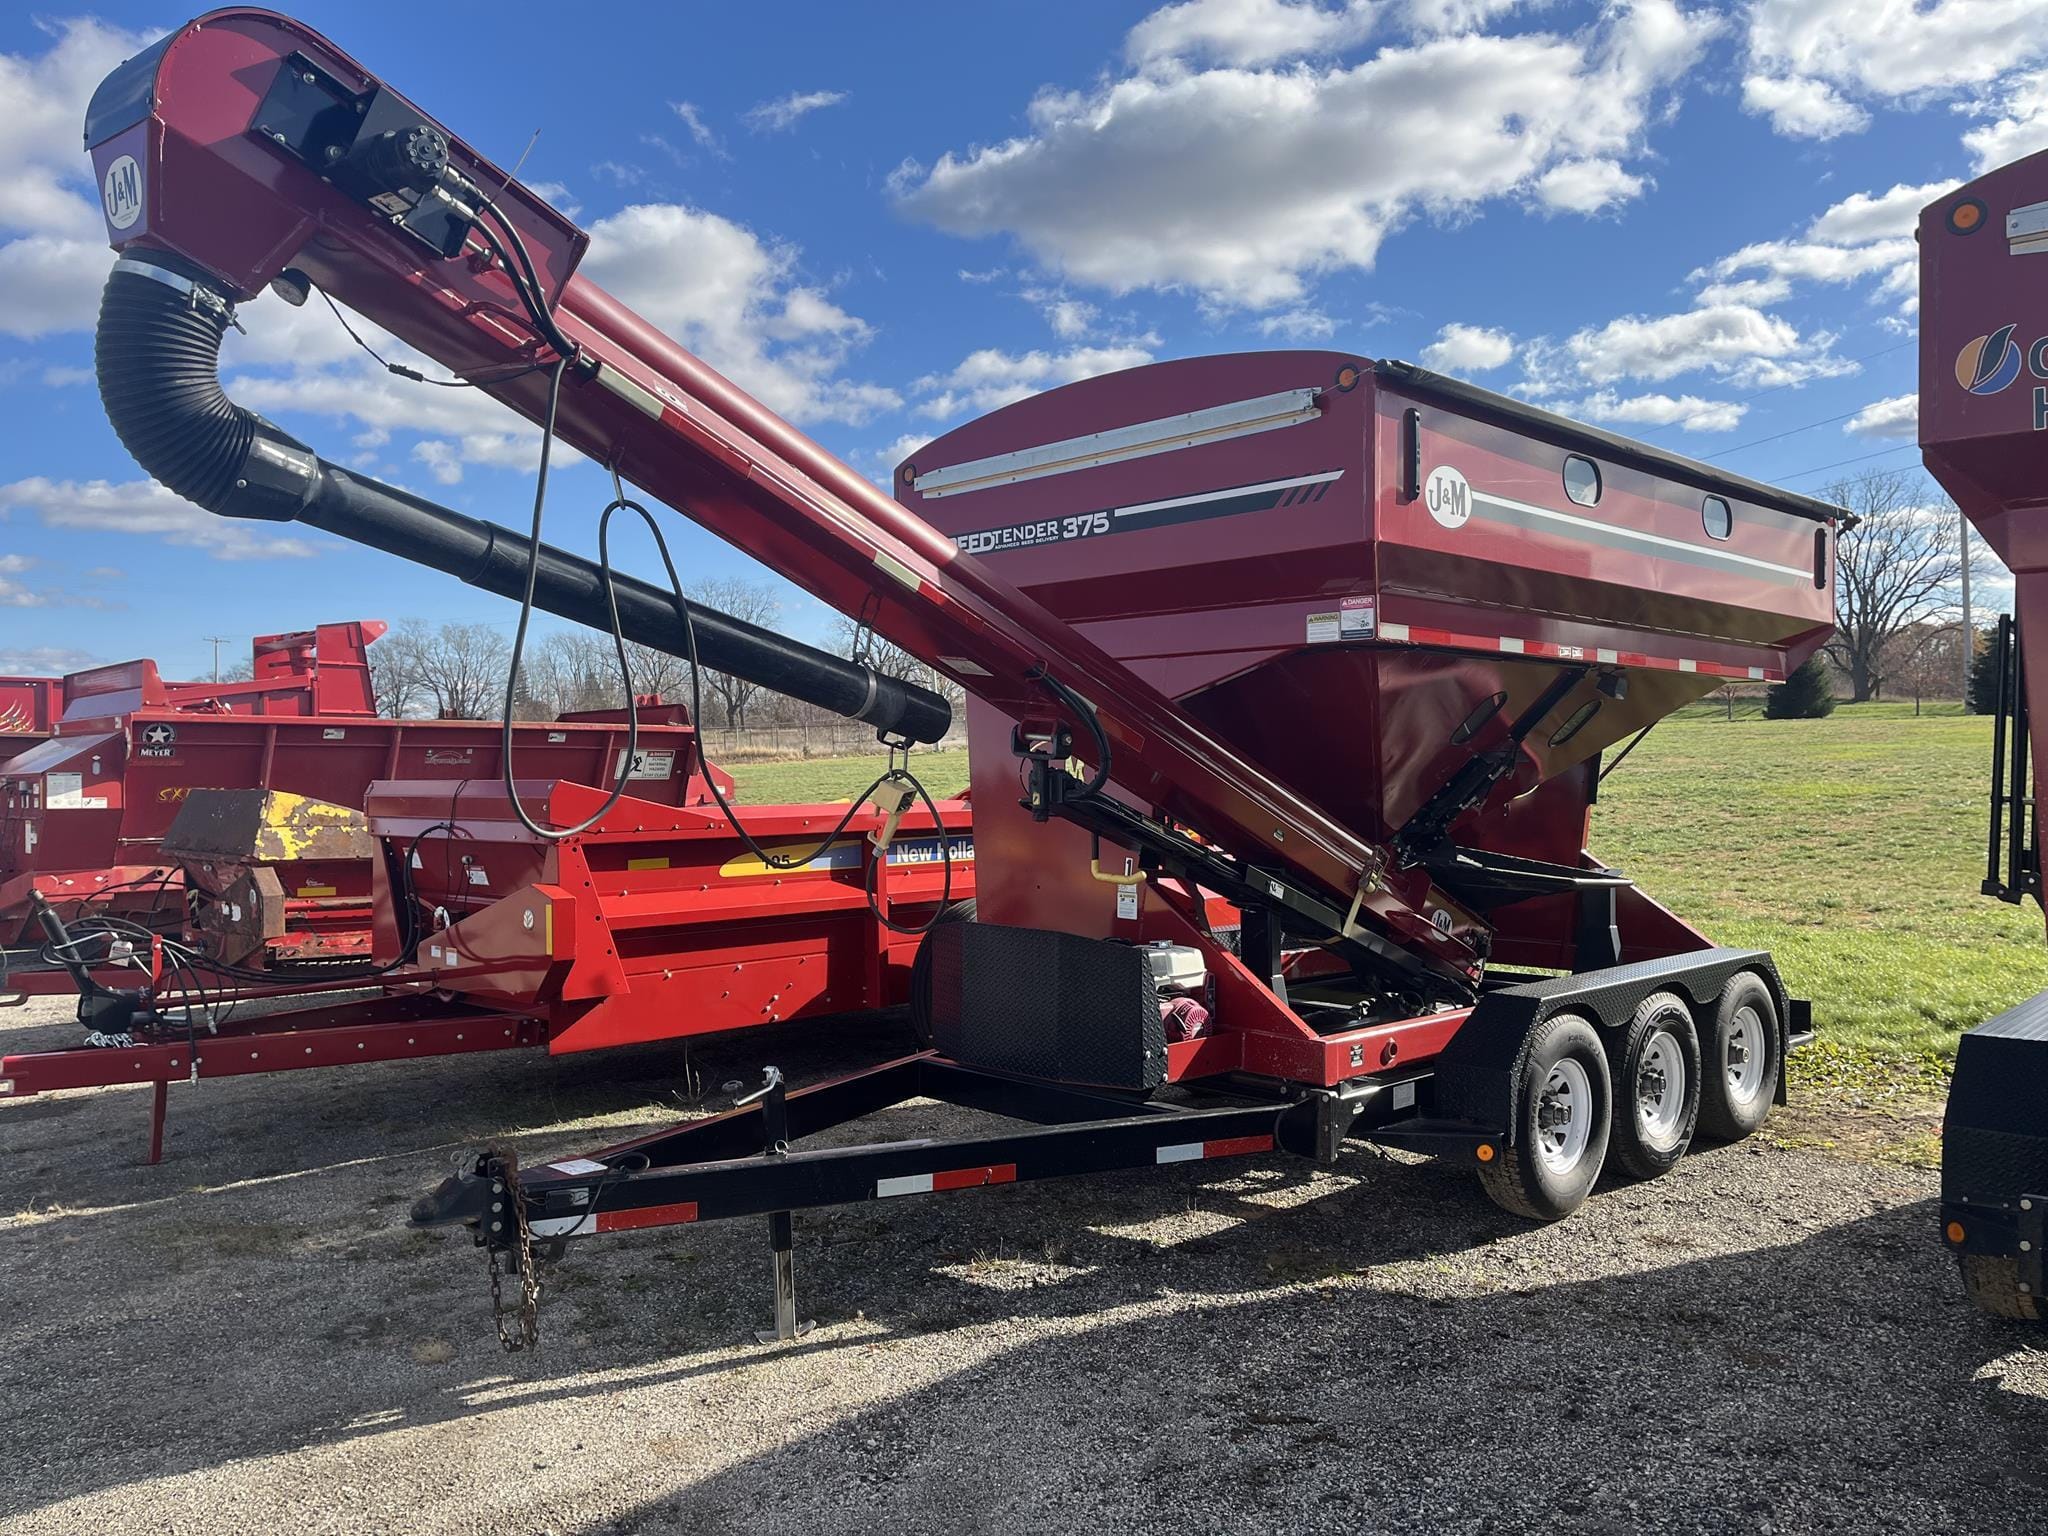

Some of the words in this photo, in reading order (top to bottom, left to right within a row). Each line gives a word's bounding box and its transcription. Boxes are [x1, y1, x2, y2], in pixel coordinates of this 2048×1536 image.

[107, 162, 139, 216] J&M
[1428, 476, 1466, 518] J&M
[1063, 512, 1110, 539] 375
[1347, 597, 1373, 605] DANGER
[140, 748, 171, 757] MEYER
[896, 843, 932, 863] New
[1432, 911, 1451, 933] J&M
